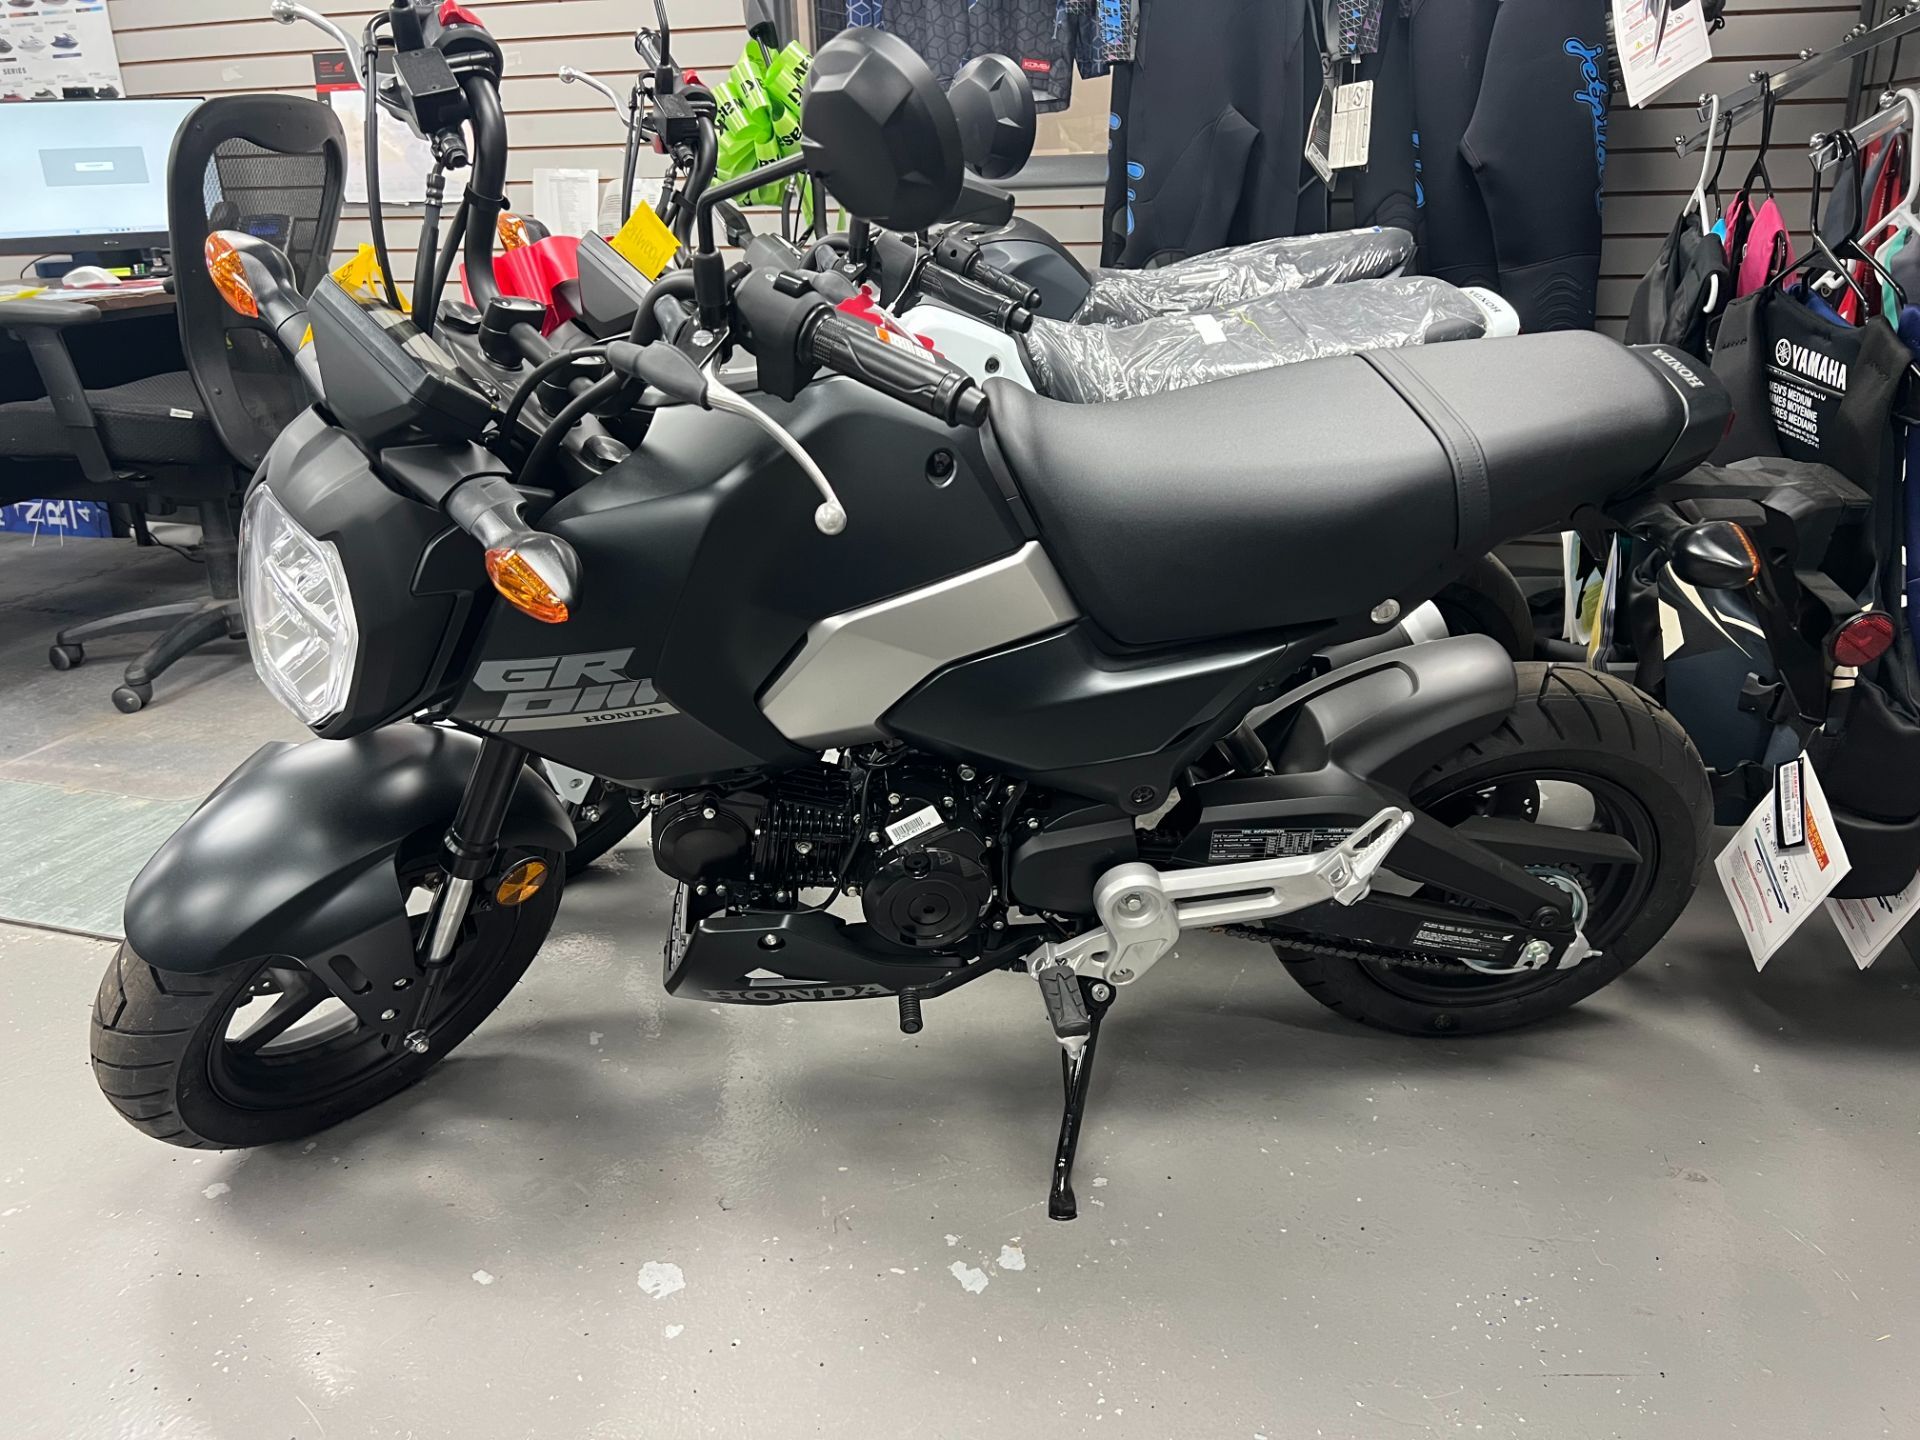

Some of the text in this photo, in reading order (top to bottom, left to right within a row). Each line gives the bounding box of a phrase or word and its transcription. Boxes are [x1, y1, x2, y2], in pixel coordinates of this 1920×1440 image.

[1652, 349, 1705, 388] HONDA
[1793, 344, 1847, 391] YAMAHA
[1787, 387, 1812, 408] MEDIUM
[1787, 399, 1818, 423] MOYENNE
[1788, 411, 1818, 434] MEDIANO
[583, 708, 664, 723] HONDA
[702, 983, 897, 1001] HONDA
